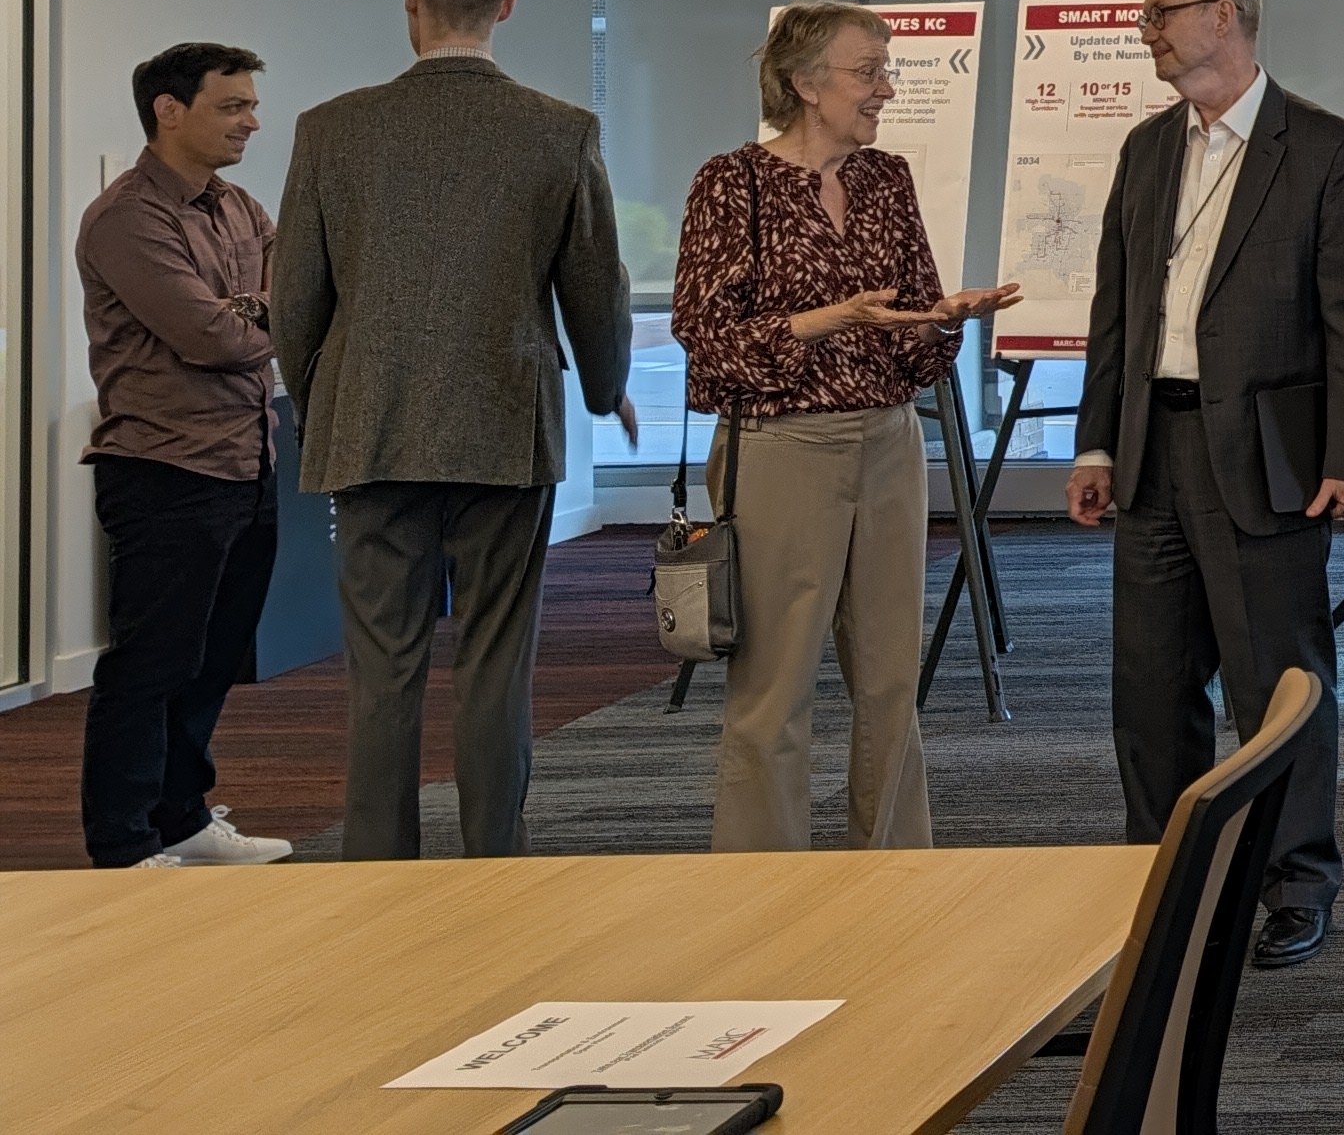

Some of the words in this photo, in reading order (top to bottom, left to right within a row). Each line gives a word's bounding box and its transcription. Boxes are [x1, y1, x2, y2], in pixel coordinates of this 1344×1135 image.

[1059, 10, 1108, 23] SMART
[924, 18, 946, 30] KC
[1070, 35, 1120, 47] Updated
[895, 58, 940, 67] Moves?
[1074, 51, 1088, 63] By
[1093, 50, 1111, 60] the
[1115, 50, 1153, 60] Numb
[899, 88, 906, 96] by
[1037, 83, 1056, 96] 12
[1080, 83, 1099, 96] 10
[1112, 82, 1131, 95] 15
[1017, 157, 1039, 165] 2034
[456, 1017, 570, 1072] WELCOME
[686, 1027, 756, 1061] MARC
